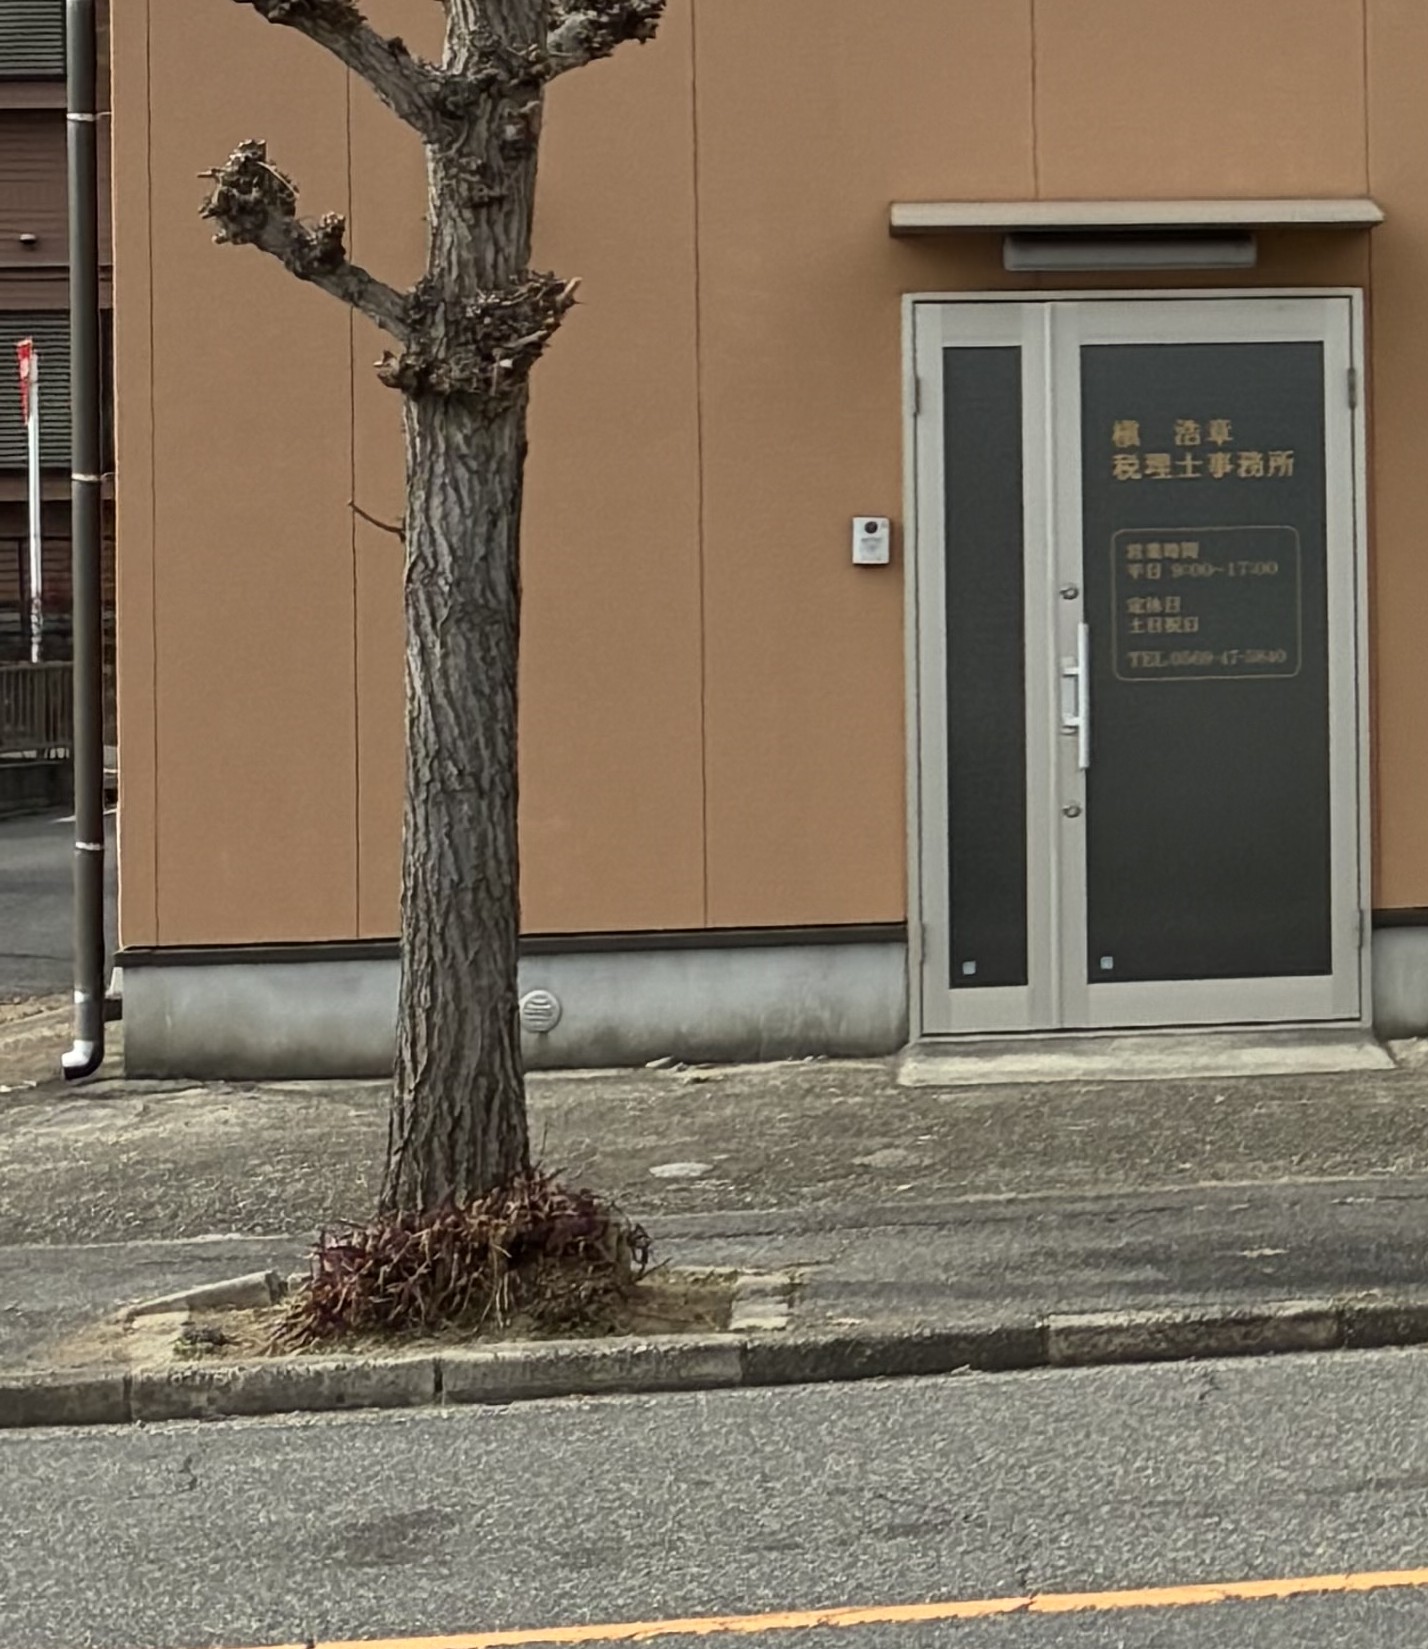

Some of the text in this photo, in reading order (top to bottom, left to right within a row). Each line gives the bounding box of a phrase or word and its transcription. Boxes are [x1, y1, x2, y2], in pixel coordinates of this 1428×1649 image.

[1112, 450, 1295, 481] 税理士事務所
